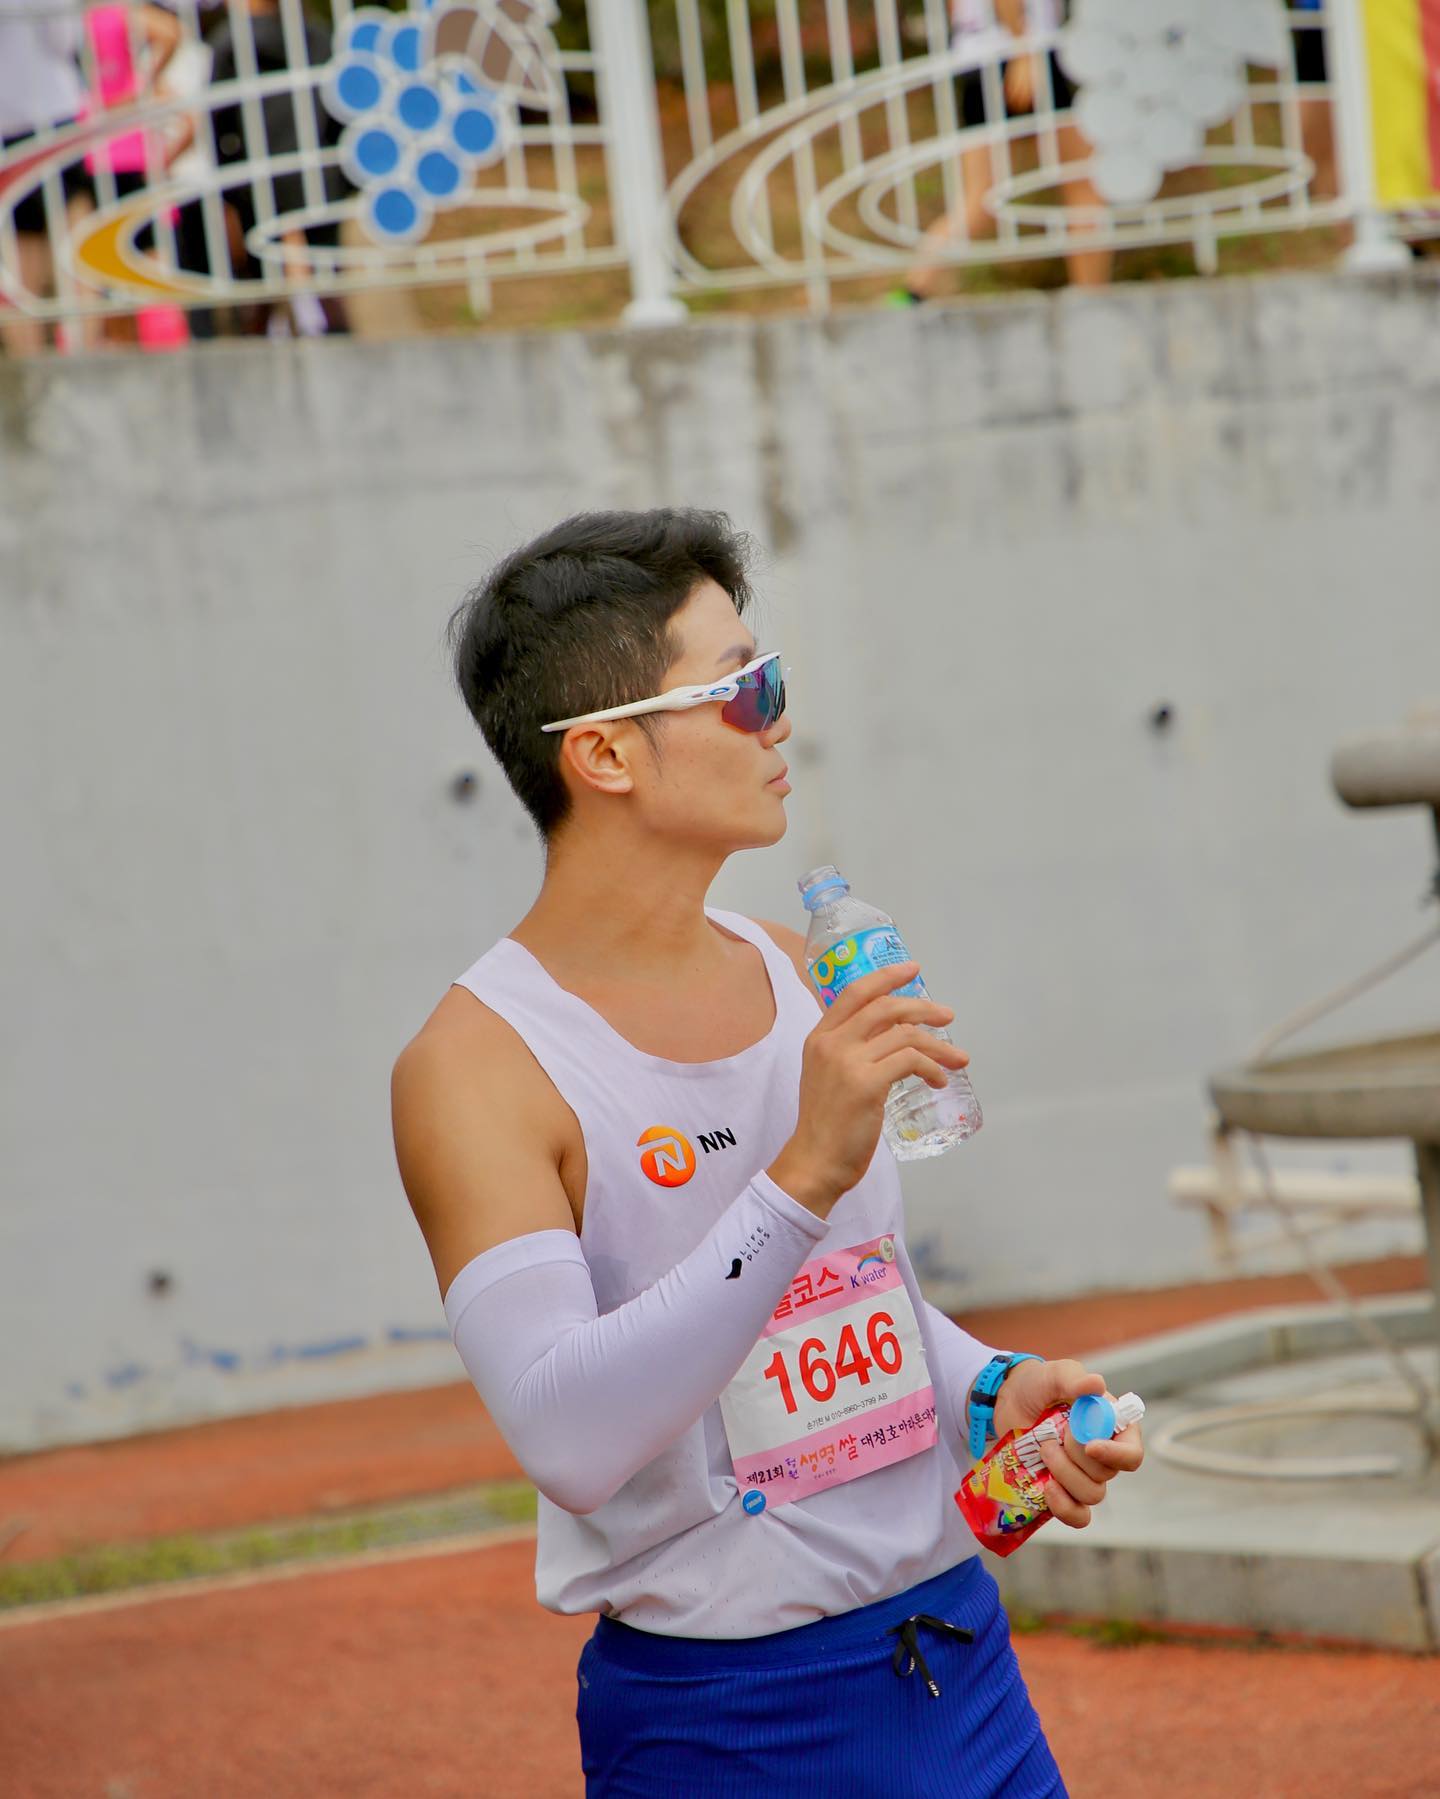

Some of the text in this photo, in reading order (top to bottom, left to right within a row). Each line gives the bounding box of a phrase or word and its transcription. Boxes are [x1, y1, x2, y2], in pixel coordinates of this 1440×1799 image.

[696, 1127, 737, 1154] NN
[739, 1226, 764, 1256] LIFE
[746, 1231, 770, 1262] PLUS
[763, 1310, 903, 1415] 1646
[745, 1464, 785, 1485] 제21회
